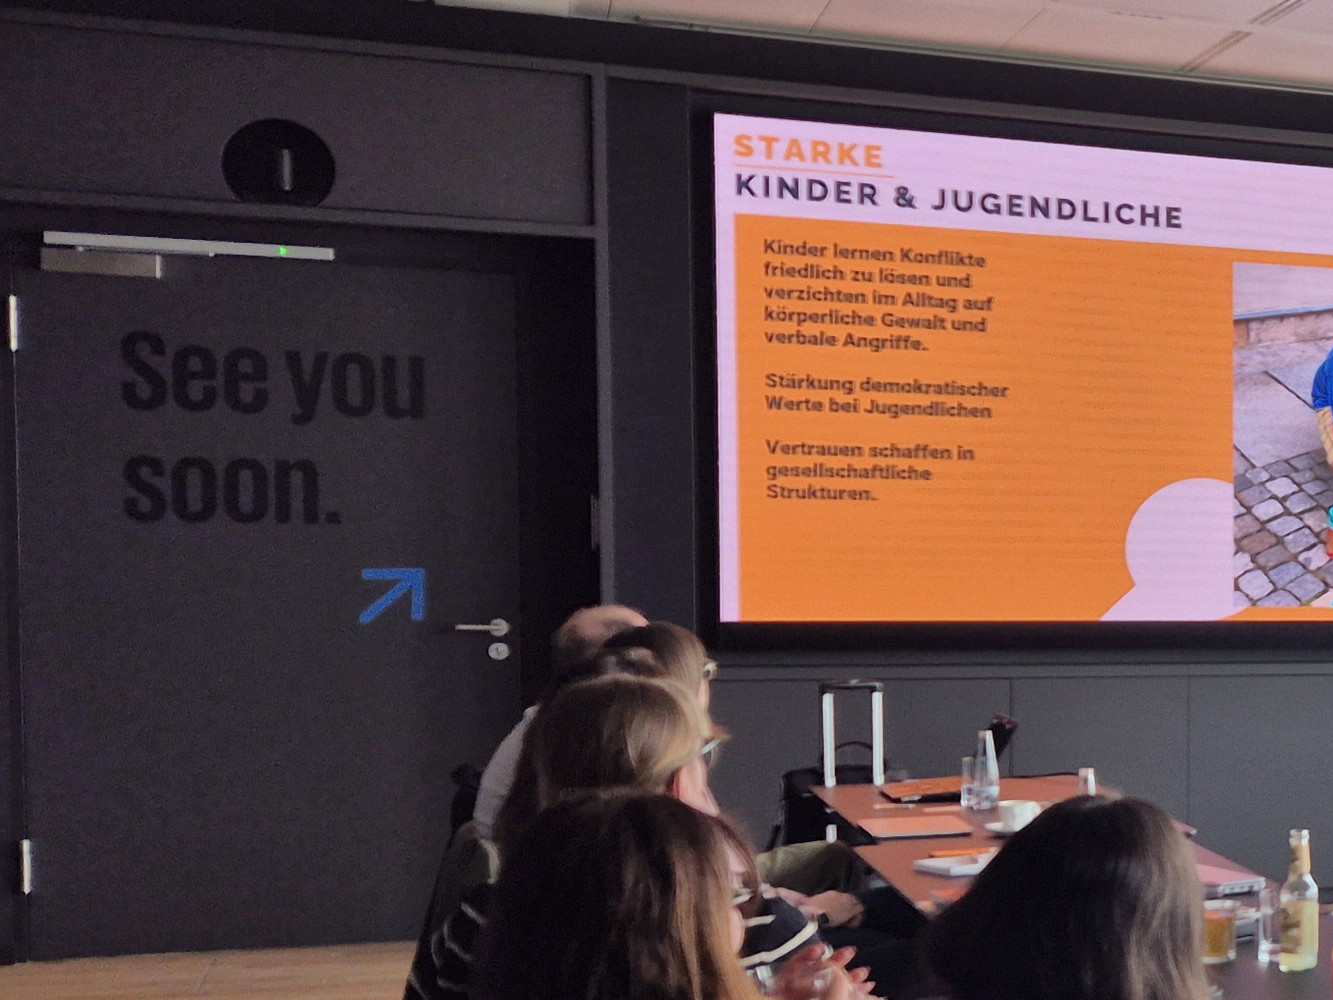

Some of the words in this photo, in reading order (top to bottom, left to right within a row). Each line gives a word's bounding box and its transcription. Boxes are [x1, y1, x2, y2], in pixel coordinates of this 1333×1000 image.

[733, 133, 884, 169] STARKE
[735, 172, 879, 207] KINDER
[893, 187, 915, 209] &
[931, 189, 1184, 229] JUGENDLICHE
[763, 238, 829, 258] Kinder
[832, 243, 895, 263] lernen
[899, 248, 987, 268] Konflikte
[764, 261, 845, 282] friedlich
[850, 268, 874, 284] zu
[879, 267, 931, 286] lösen
[935, 273, 973, 289] und
[764, 285, 867, 305] verzichten
[872, 289, 897, 307] im
[901, 291, 958, 313] Alltag
[962, 295, 995, 312] auf
[764, 306, 876, 330] körperliche
[881, 312, 947, 331] Gewalt
[951, 316, 987, 333] und
[764, 330, 839, 348] verbale
[842, 331, 930, 353] Angriffe.
[119, 329, 270, 415] See
[284, 349, 427, 427] you
[765, 373, 854, 396] Stärkung
[859, 377, 1011, 398] demokratischer
[765, 395, 824, 413] Werte
[828, 398, 861, 415] bei
[864, 400, 993, 420] Jugendlichen
[765, 440, 863, 459] Vertrauen
[868, 443, 953, 461] schaffen
[956, 445, 976, 462] in
[765, 463, 933, 482] gesellschaftliche
[122, 455, 342, 526] soon.
[766, 485, 878, 501] Strukturen.
